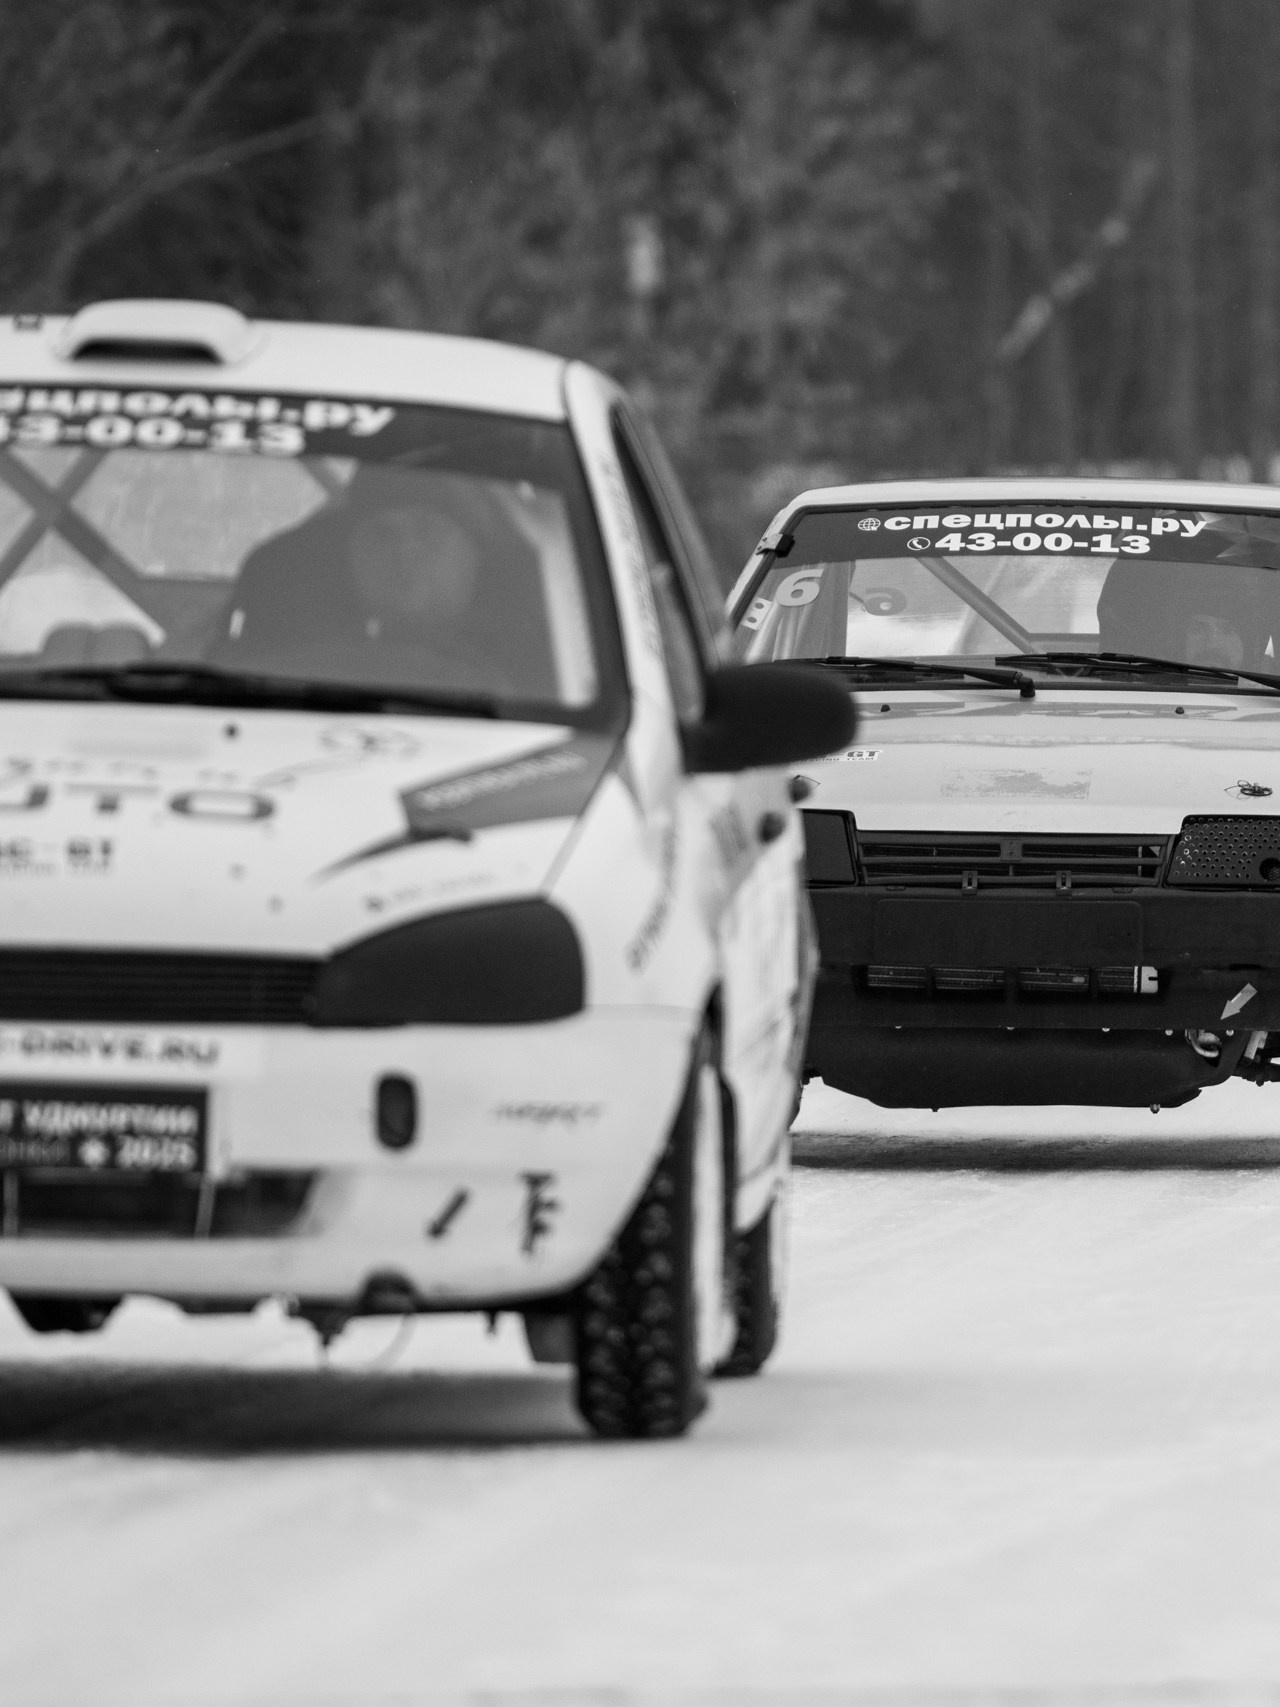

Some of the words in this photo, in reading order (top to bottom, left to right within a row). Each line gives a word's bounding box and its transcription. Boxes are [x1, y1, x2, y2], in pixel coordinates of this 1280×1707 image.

[0, 413, 305, 457] 3-00-13
[884, 513, 1206, 537] спецполы.ру
[935, 532, 1150, 554] 43-00-13
[775, 568, 824, 607] 6
